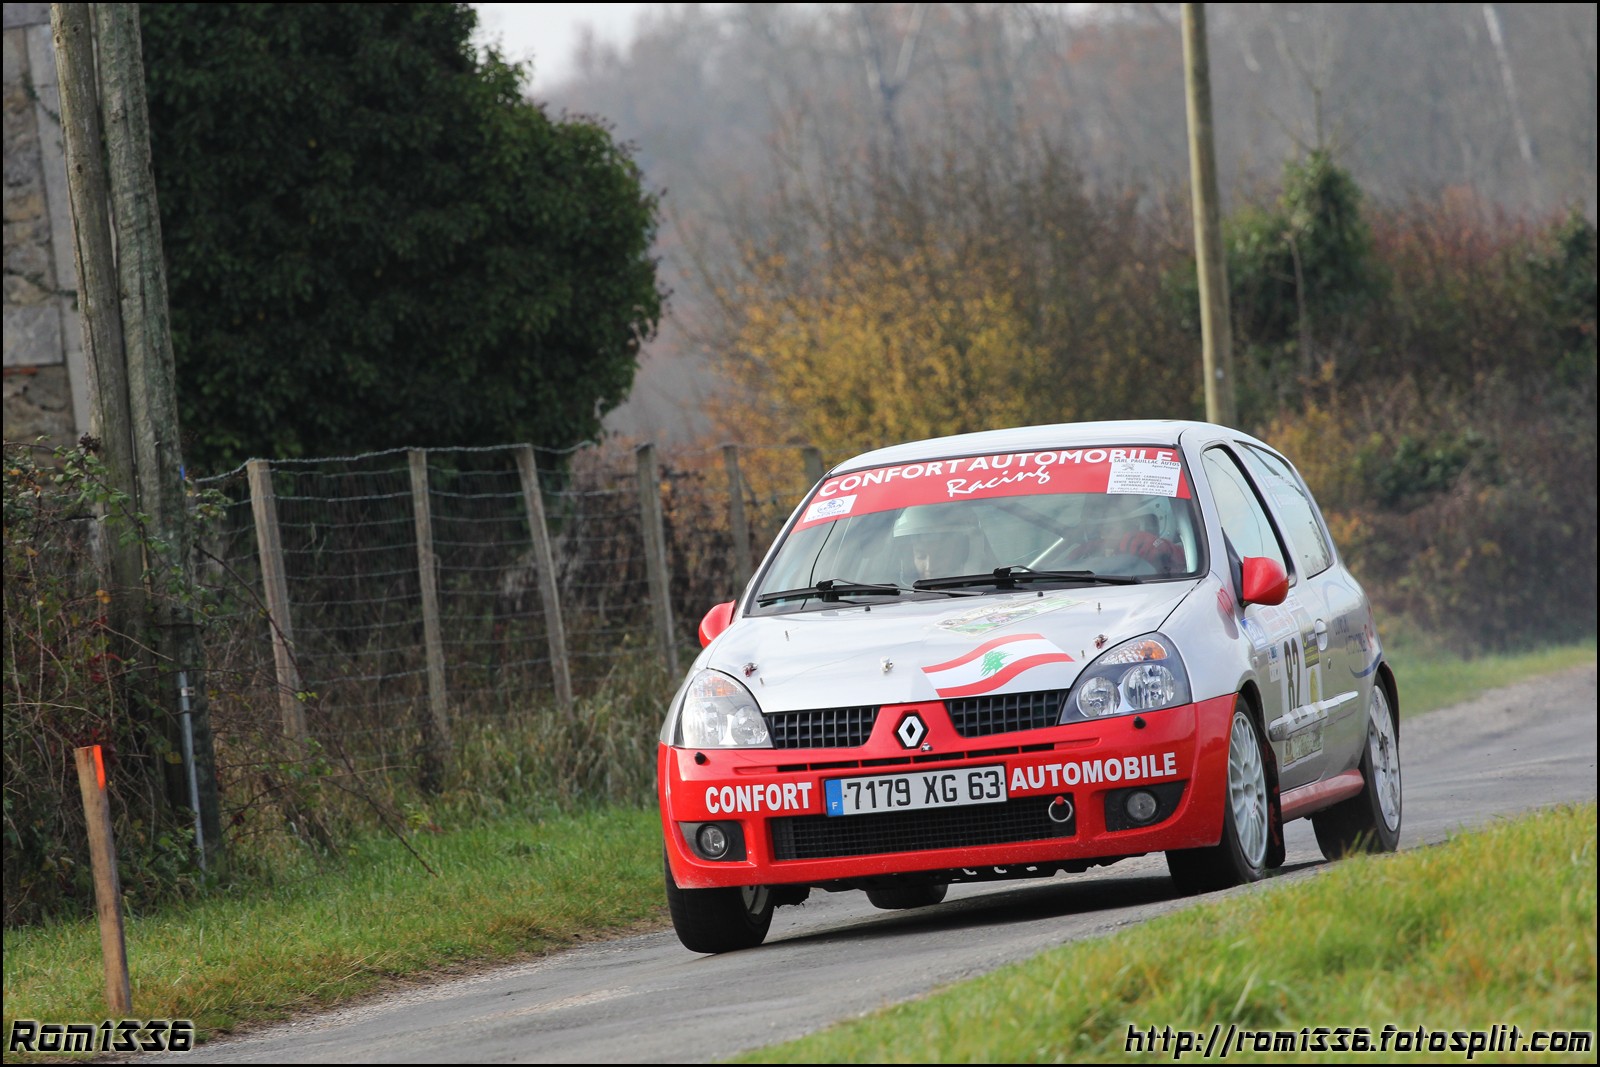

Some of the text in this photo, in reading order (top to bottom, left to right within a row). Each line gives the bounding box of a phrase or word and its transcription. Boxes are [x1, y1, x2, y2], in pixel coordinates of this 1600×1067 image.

[820, 449, 1175, 497] CONFORT AUTOMOBILE
[947, 465, 1051, 497] Racing
[1284, 637, 1303, 712] 82
[832, 770, 1000, 810] F 7179 XG 63
[1010, 752, 1177, 791] AUTOMOBILE
[705, 782, 812, 814] CONFORT
